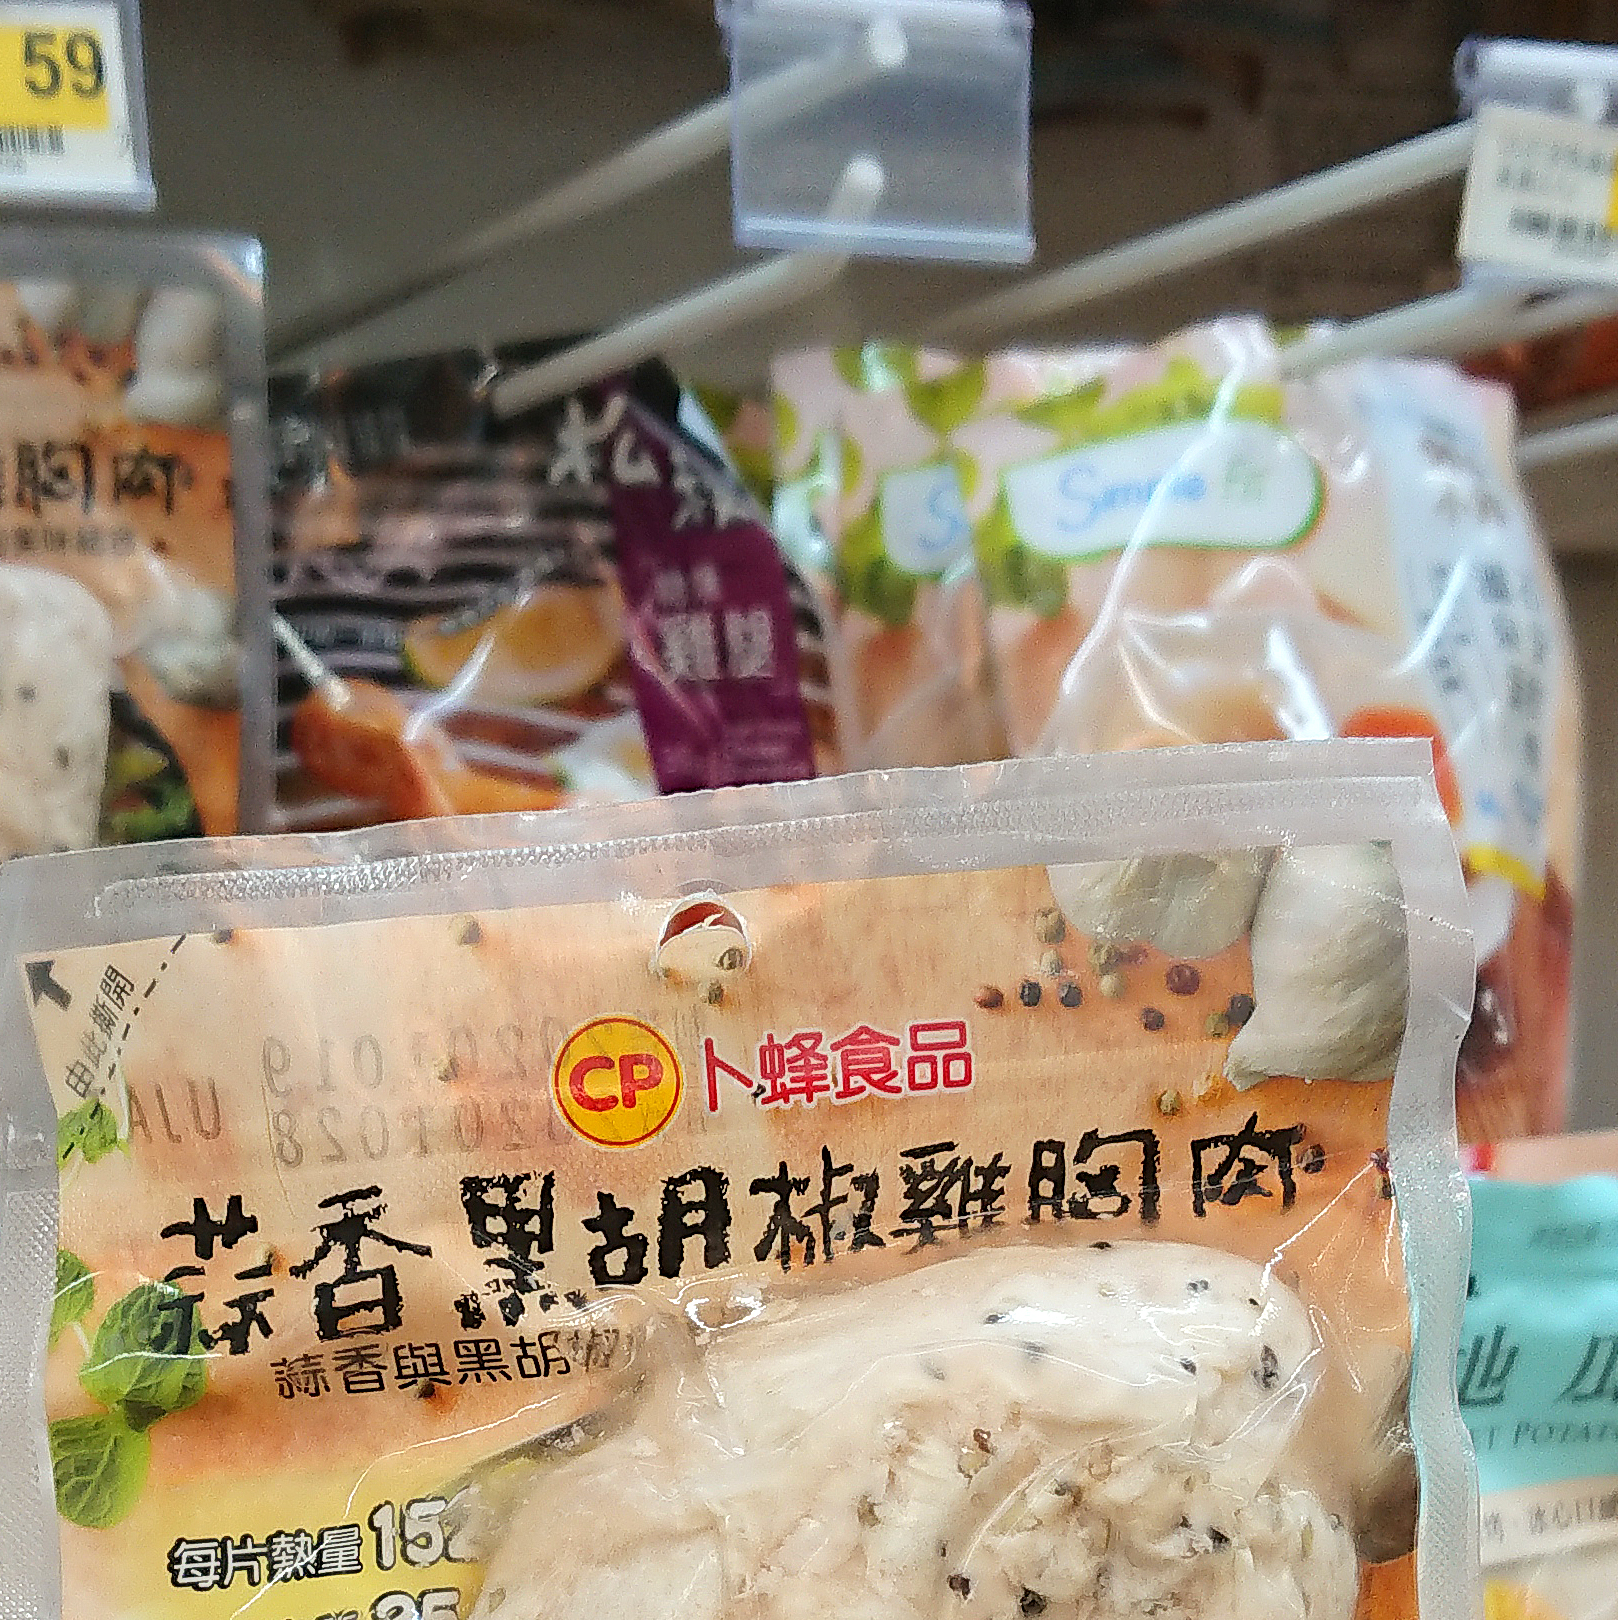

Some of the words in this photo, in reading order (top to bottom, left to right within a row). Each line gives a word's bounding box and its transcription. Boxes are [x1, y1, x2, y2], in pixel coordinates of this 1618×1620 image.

[24, 30, 105, 99] 59
[65, 963, 135, 1098] 由此撕開
[703, 1019, 975, 1112] 卜蜂食品
[568, 1053, 665, 1113] CP
[159, 1112, 1309, 1357] 蒜香黑胡椒雞胸肉
